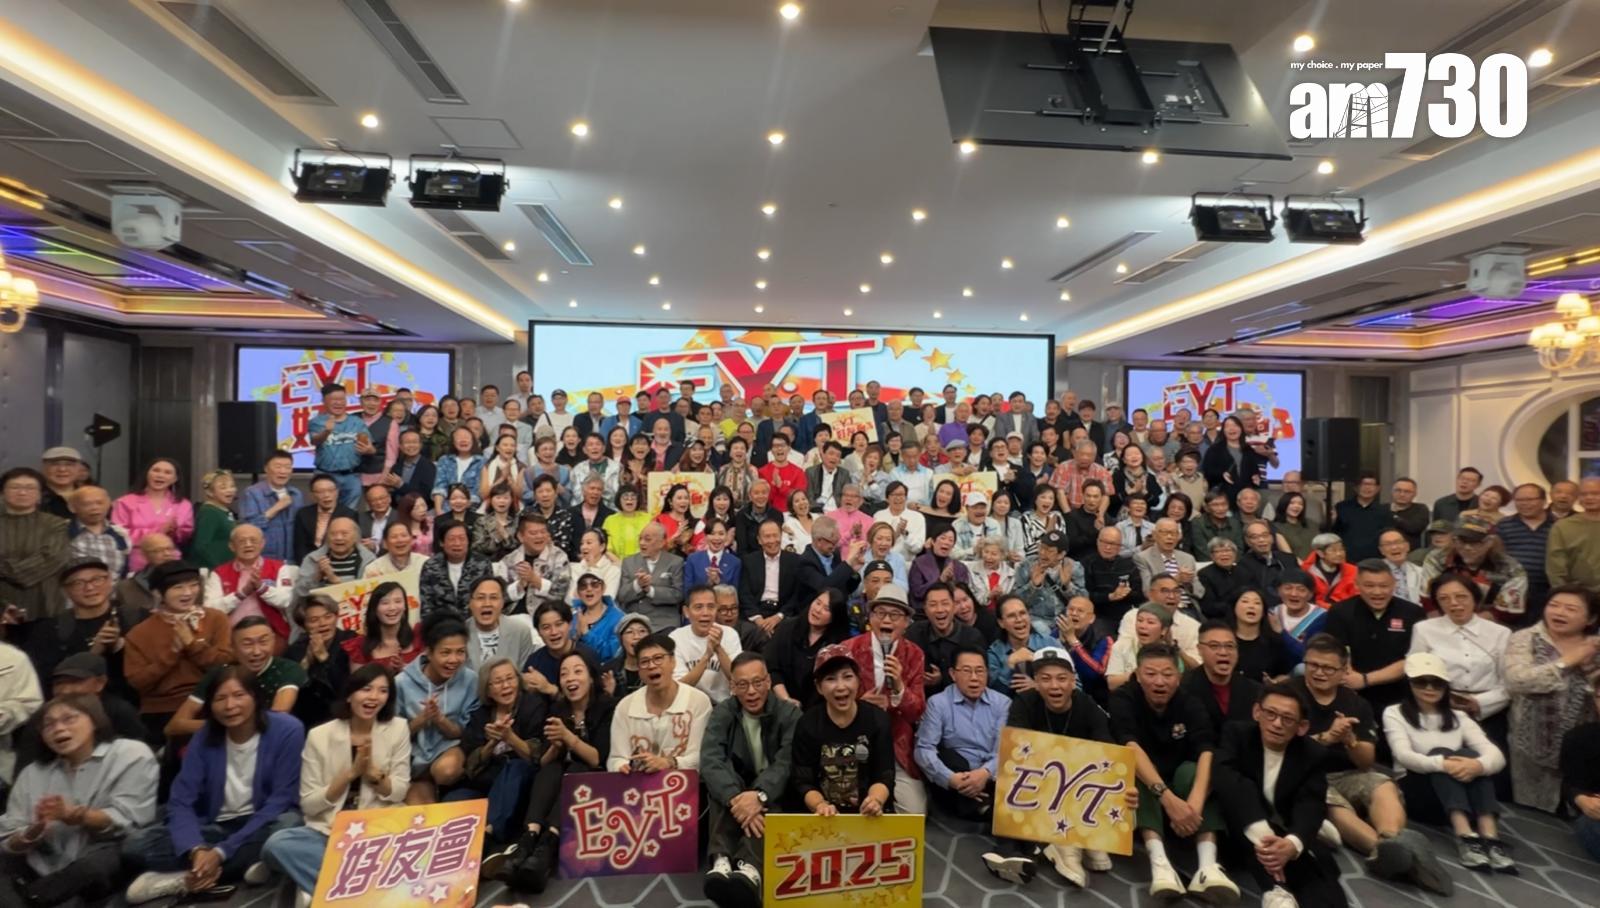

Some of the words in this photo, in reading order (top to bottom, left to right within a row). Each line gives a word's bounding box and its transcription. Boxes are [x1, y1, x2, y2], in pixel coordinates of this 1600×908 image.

[1005, 760, 1124, 826] EYT
[326, 815, 480, 901] 好友會
[774, 838, 917, 900] 2025
